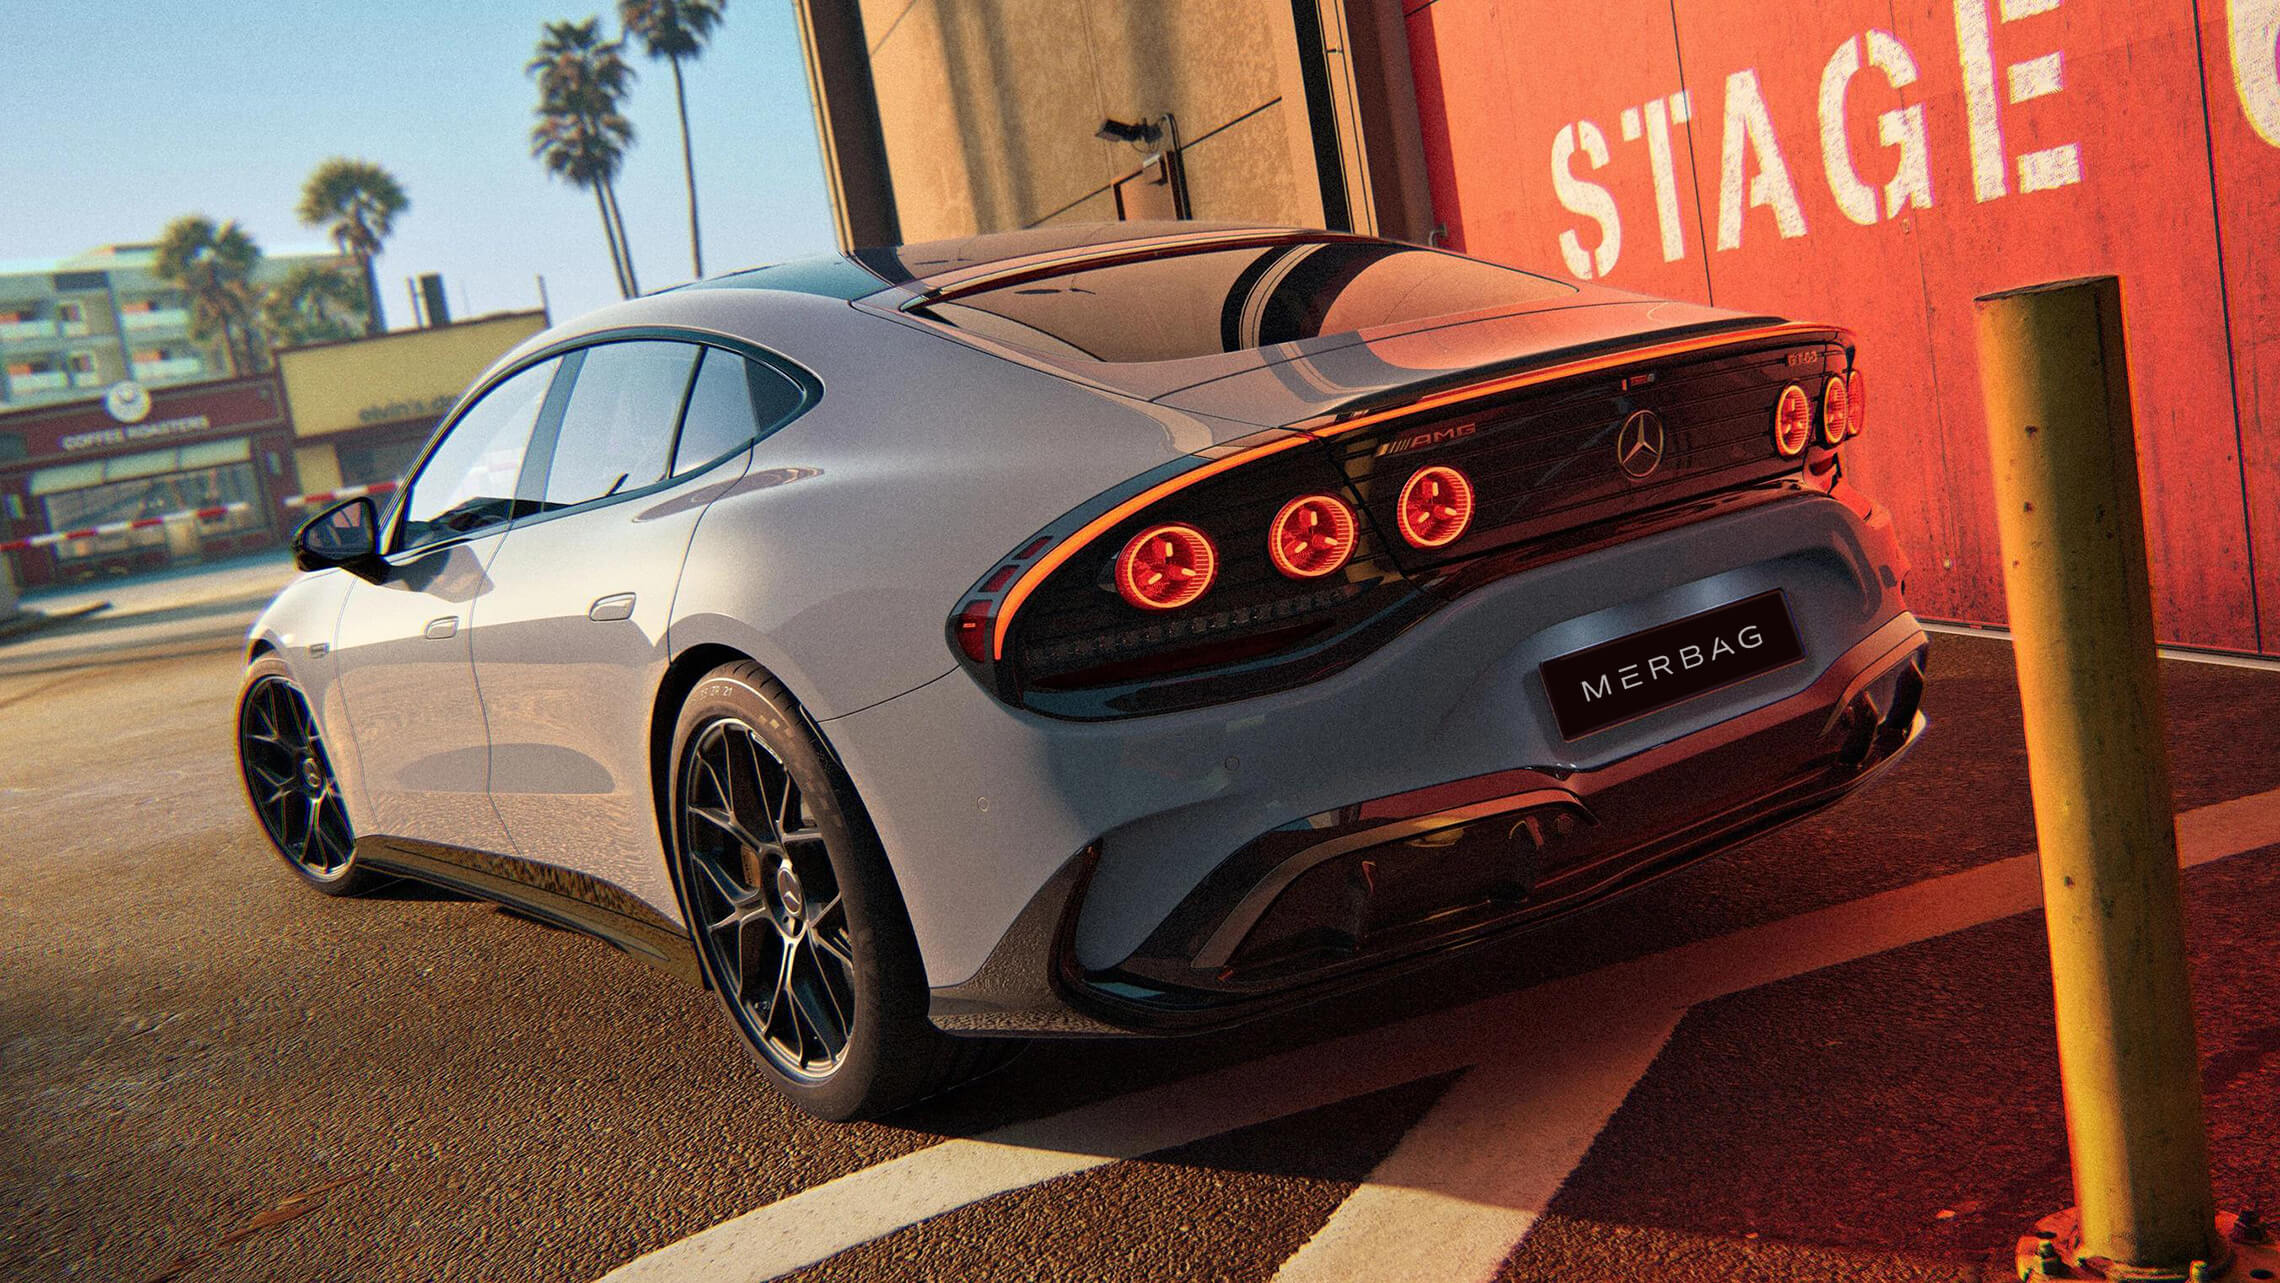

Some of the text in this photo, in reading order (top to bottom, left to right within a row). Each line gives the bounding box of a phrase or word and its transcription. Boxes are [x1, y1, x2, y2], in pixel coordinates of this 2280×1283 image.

[1551, 0, 2083, 281] STAGE
[62, 415, 210, 450] COFFEE ROASTERS
[1580, 625, 1763, 702] MERBAG
